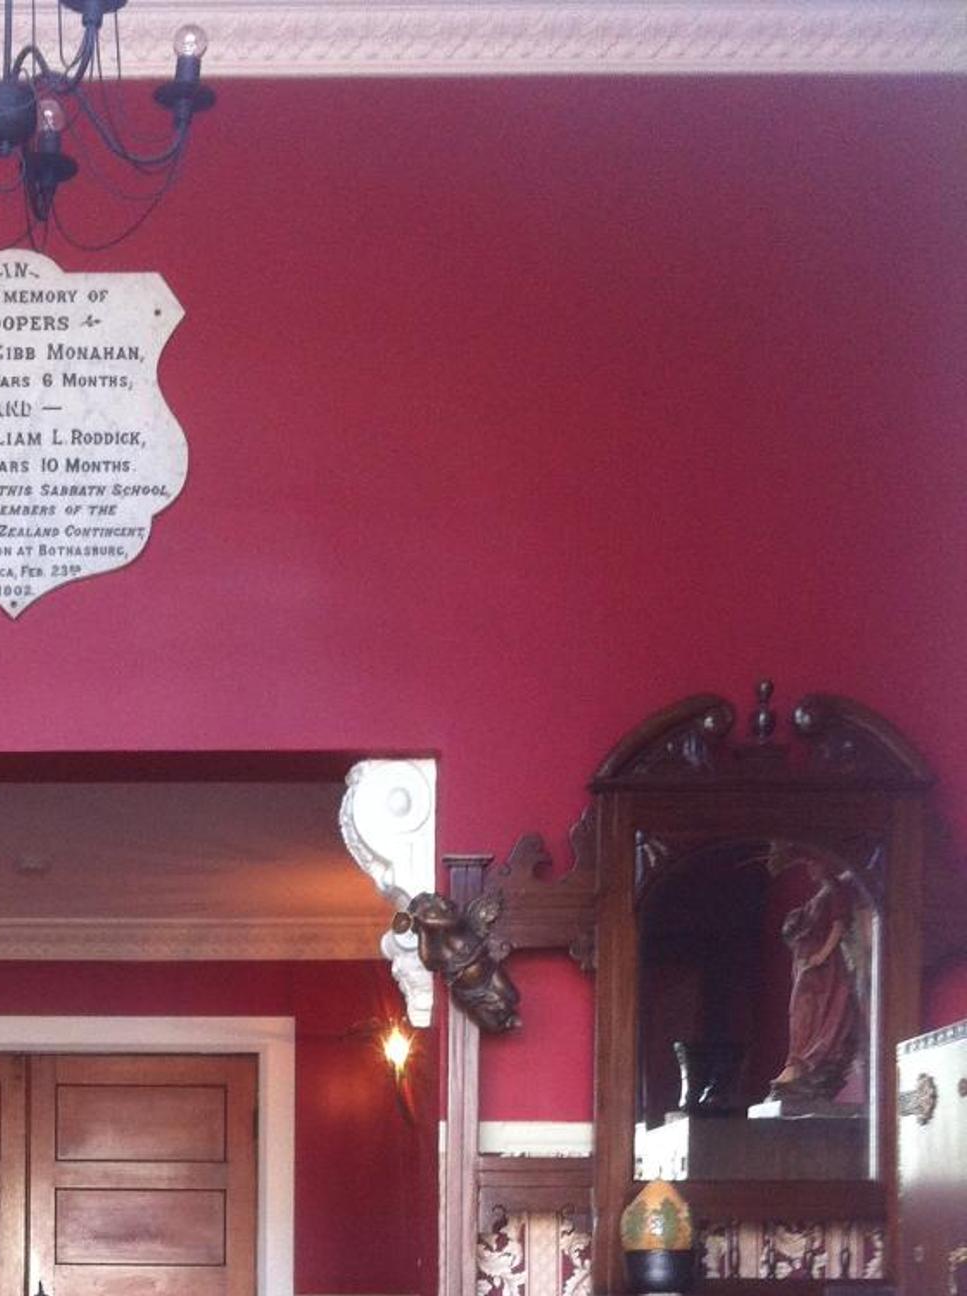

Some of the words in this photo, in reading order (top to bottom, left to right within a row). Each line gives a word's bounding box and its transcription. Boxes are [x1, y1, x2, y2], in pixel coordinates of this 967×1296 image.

[4, 290, 77, 304] MEMORY
[87, 290, 109, 303] OF
[47, 343, 144, 363] MONAHAN,
[42, 373, 53, 388] 6
[41, 458, 59, 473] 10
[40, 484, 107, 497] SABBATH
[64, 505, 82, 516] OF
[89, 505, 118, 516] THE
[16, 546, 33, 556] AT
